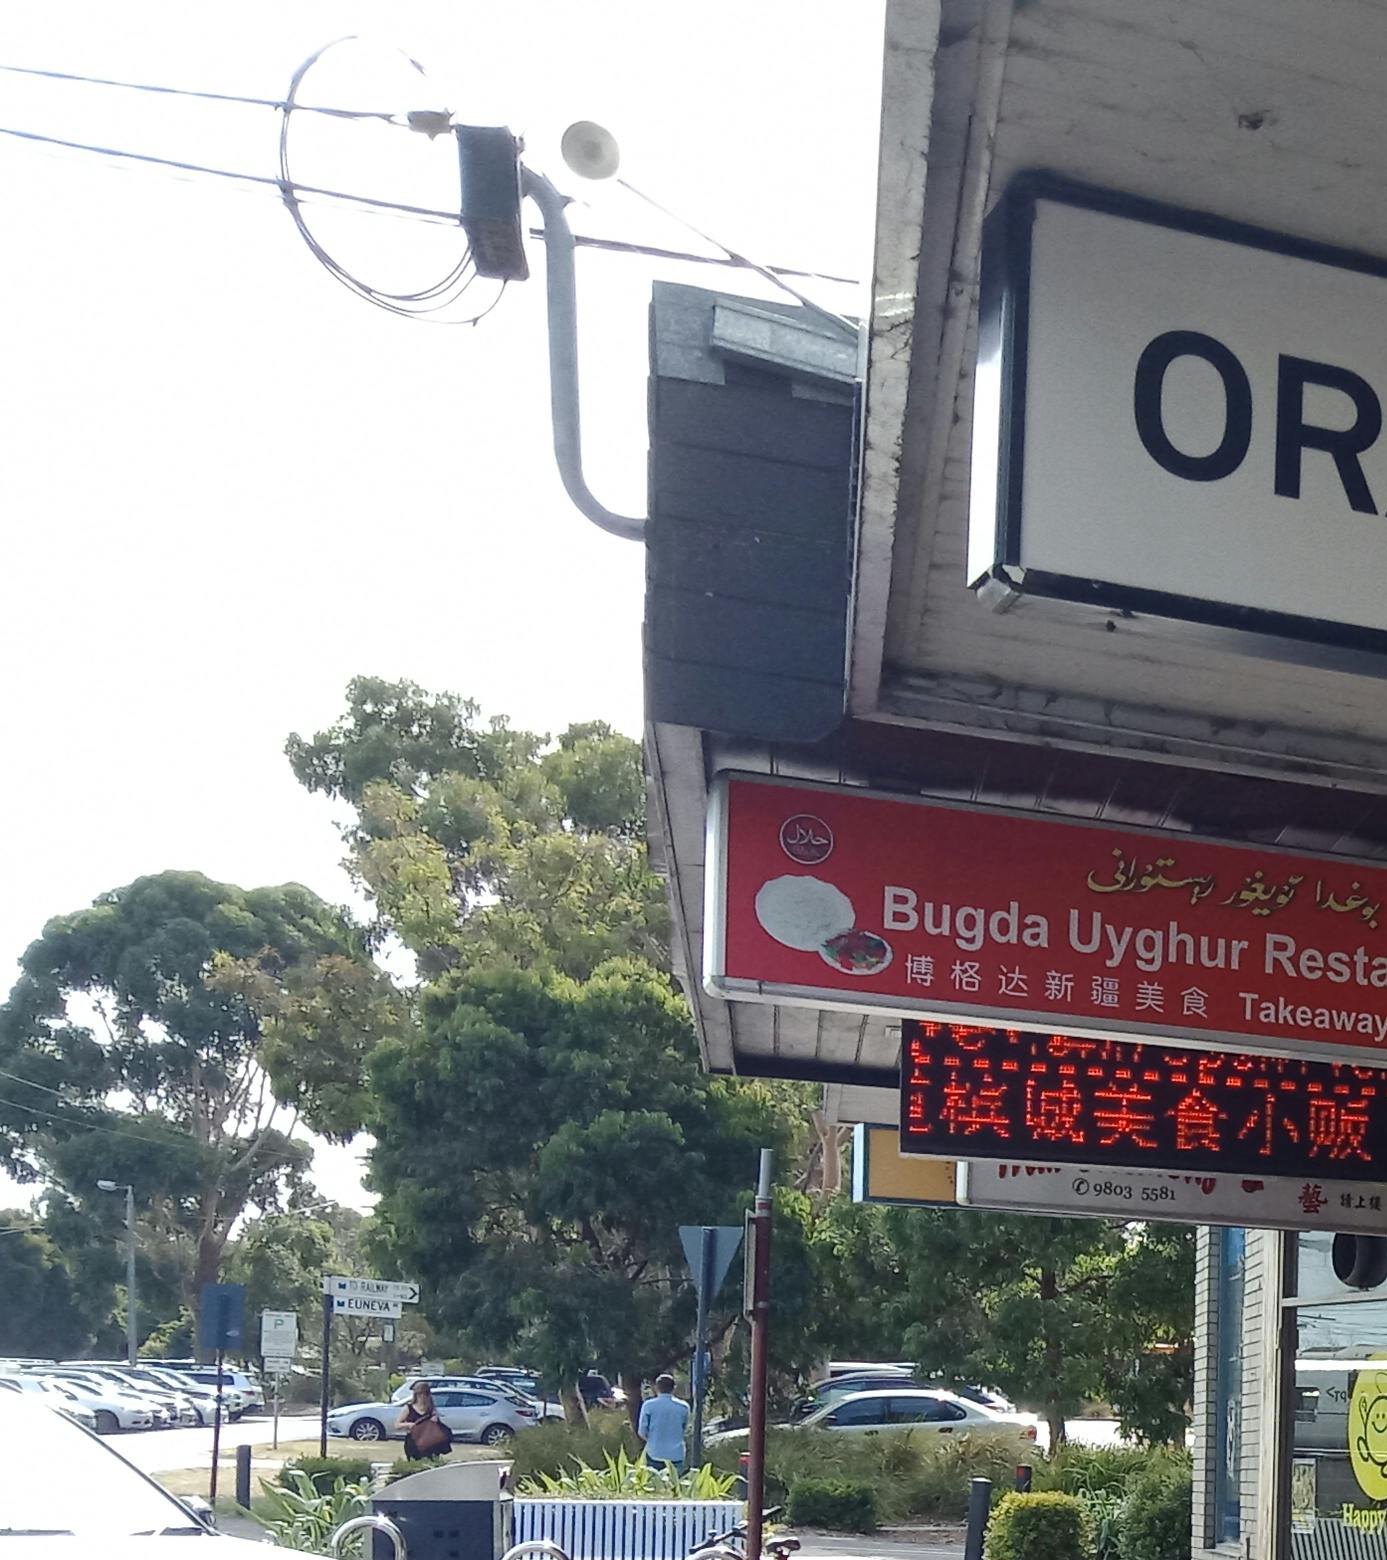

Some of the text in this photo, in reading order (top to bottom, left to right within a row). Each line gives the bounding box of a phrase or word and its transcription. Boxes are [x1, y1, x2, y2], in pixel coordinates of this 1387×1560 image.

[881, 885, 1049, 952] Bugda
[1068, 908, 1249, 973] Uyghur
[905, 953, 1210, 1019] 博格达新疆美食
[1093, 1182, 1176, 1202] 9803 5581
[348, 1298, 390, 1312] EUNEVA
[1342, 1503, 1386, 1536] Happy
